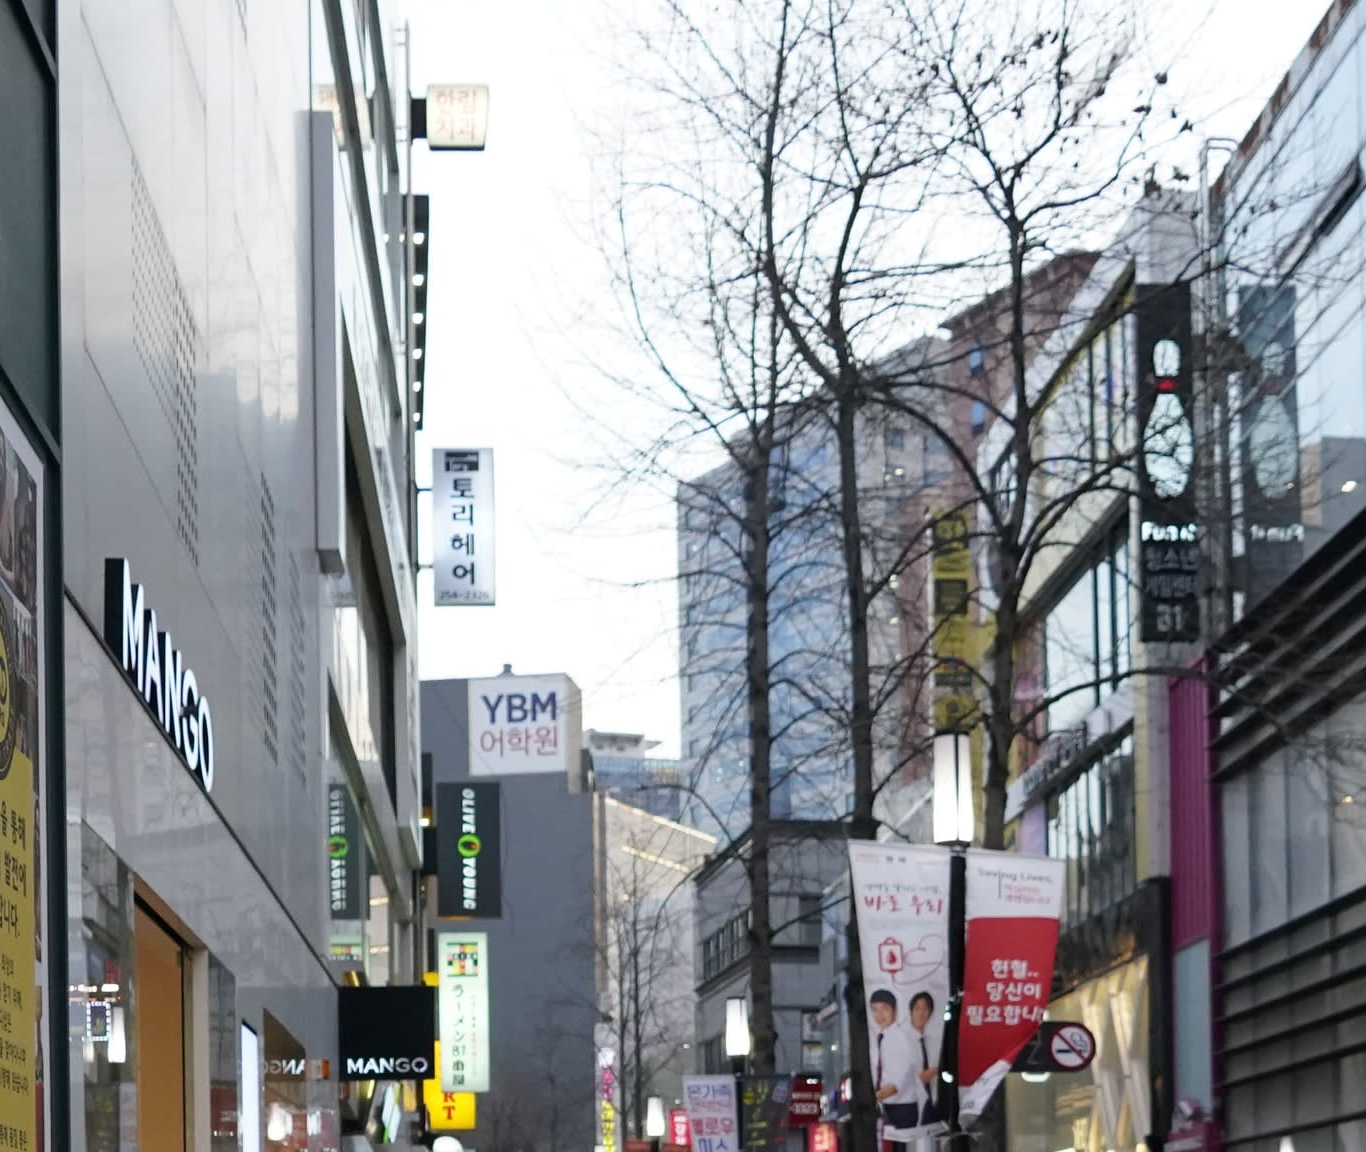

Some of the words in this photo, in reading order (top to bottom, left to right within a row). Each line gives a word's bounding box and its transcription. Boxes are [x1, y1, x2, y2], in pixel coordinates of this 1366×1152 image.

[450, 477, 475, 585] 토리헤어
[122, 557, 214, 792] MANGO
[480, 691, 557, 724] YBM
[479, 727, 558, 756] 어학원
[10, 808, 27, 850] 통해
[462, 788, 476, 834] OLIVE
[3, 850, 27, 898] 발전에
[462, 857, 477, 910] YOUNG
[986, 982, 1042, 1002] 당신이
[347, 1057, 429, 1075] MANGO
